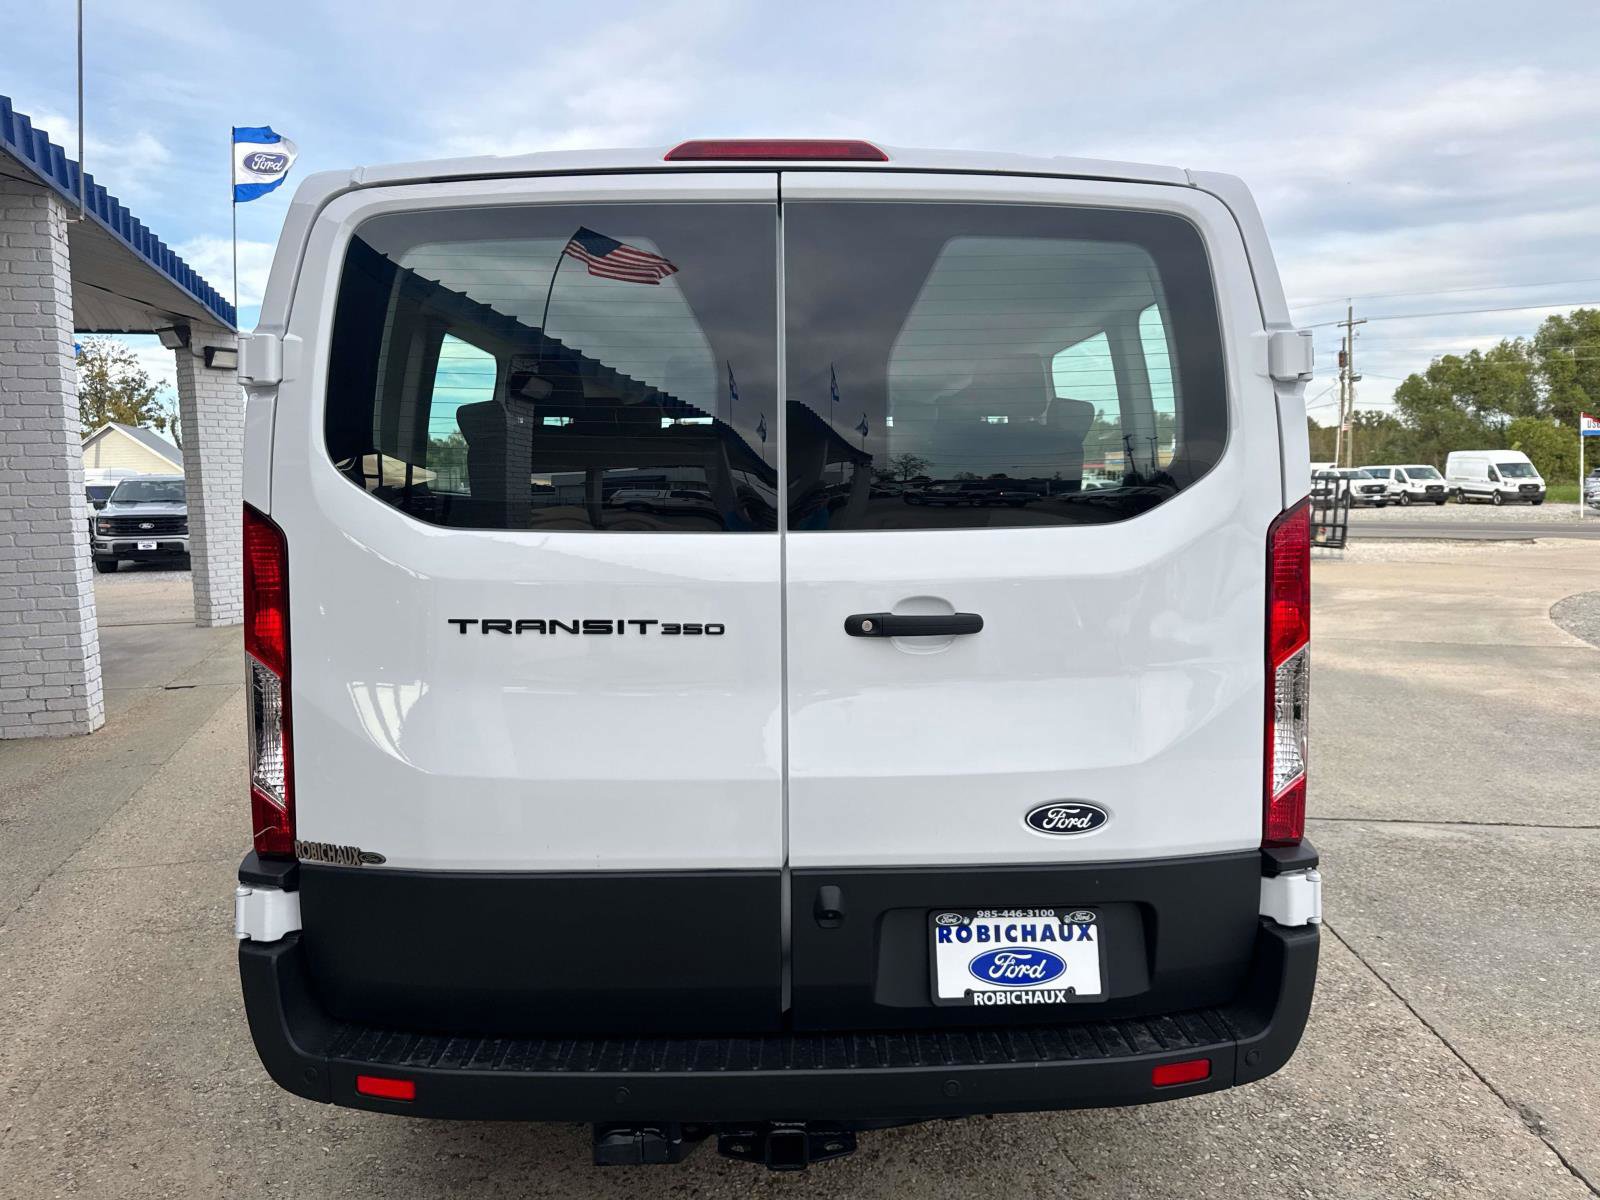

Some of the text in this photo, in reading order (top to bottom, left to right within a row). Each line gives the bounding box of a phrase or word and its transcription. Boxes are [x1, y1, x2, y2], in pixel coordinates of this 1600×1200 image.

[252, 154, 284, 171] Ford
[448, 618, 725, 635] TRANSIT 350
[1042, 808, 1093, 829] Ford
[294, 840, 361, 866] ROBICHAUX
[976, 909, 1055, 919] 985-446-3100
[938, 924, 1094, 943] ROBICHAUX
[988, 952, 1046, 979] Ford
[973, 990, 1067, 1006] ROBICHAUX
